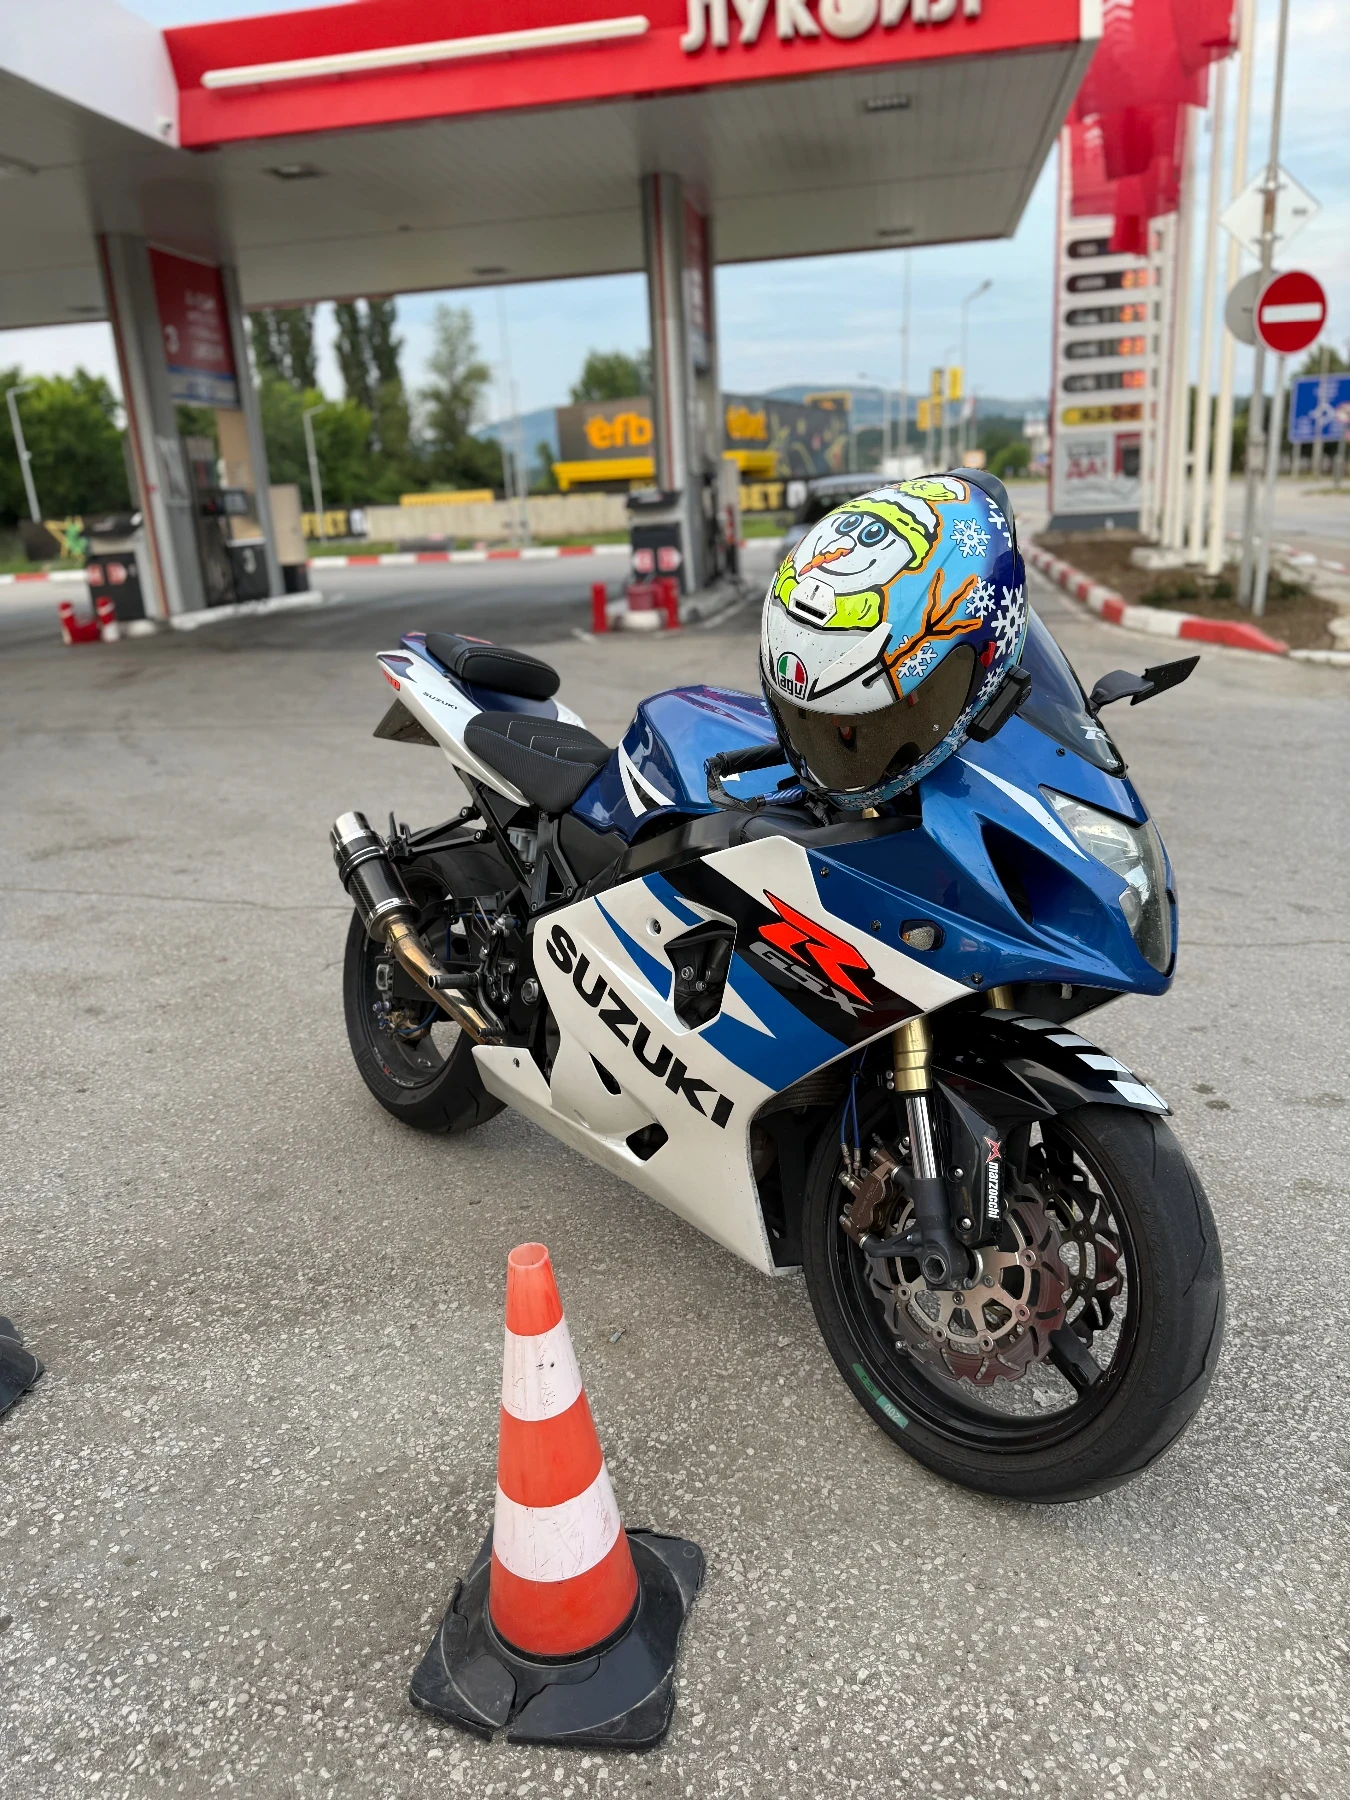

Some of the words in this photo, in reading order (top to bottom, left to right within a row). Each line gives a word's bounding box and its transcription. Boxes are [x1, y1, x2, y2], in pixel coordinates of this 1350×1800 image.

[423, 691, 458, 710] SUZUKI
[748, 941, 875, 1019] GSX
[546, 924, 735, 1130] SUZUKI
[987, 1161, 1000, 1220] marzocchi
[884, 1403, 901, 1421] 200
